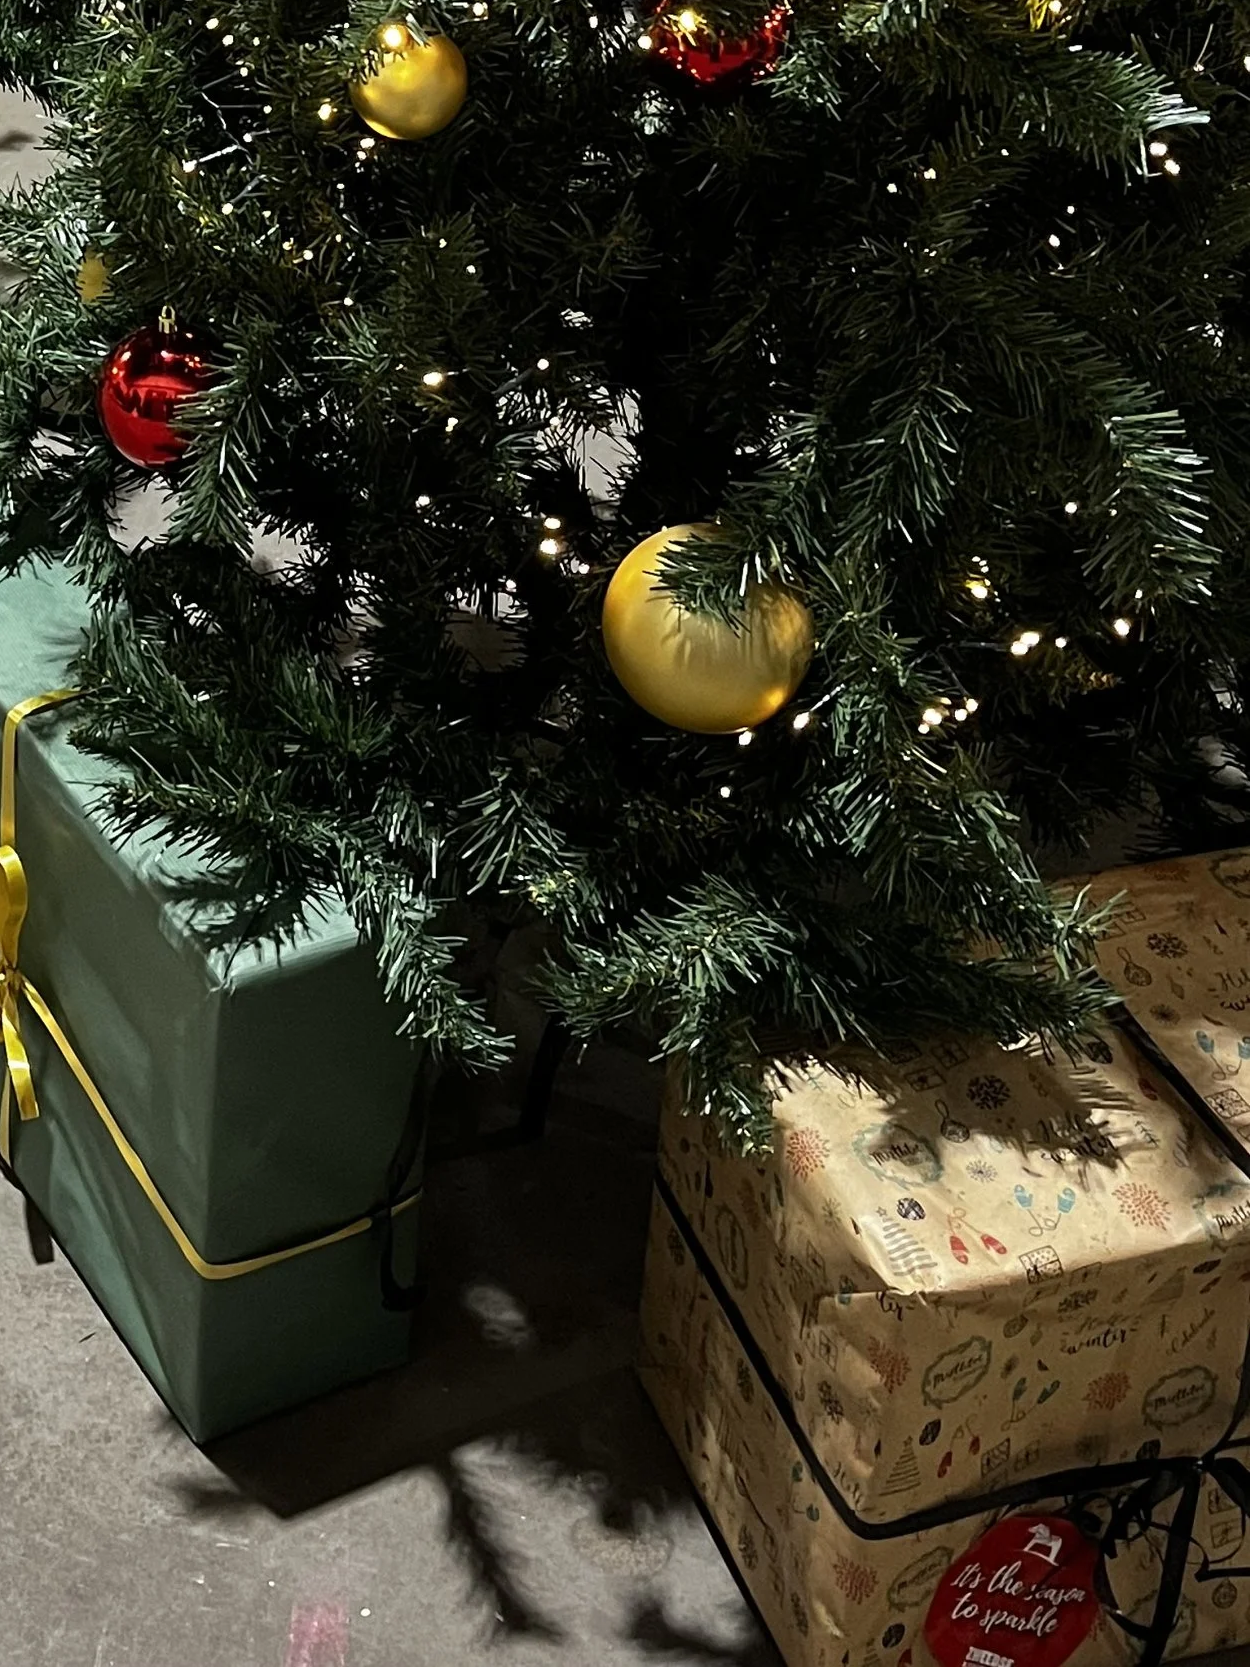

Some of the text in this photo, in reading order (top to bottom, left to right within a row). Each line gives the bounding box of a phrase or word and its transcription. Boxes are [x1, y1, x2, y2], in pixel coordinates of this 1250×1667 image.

[986, 1560, 1024, 1596] the
[950, 1591, 1059, 1637] to sparkle
